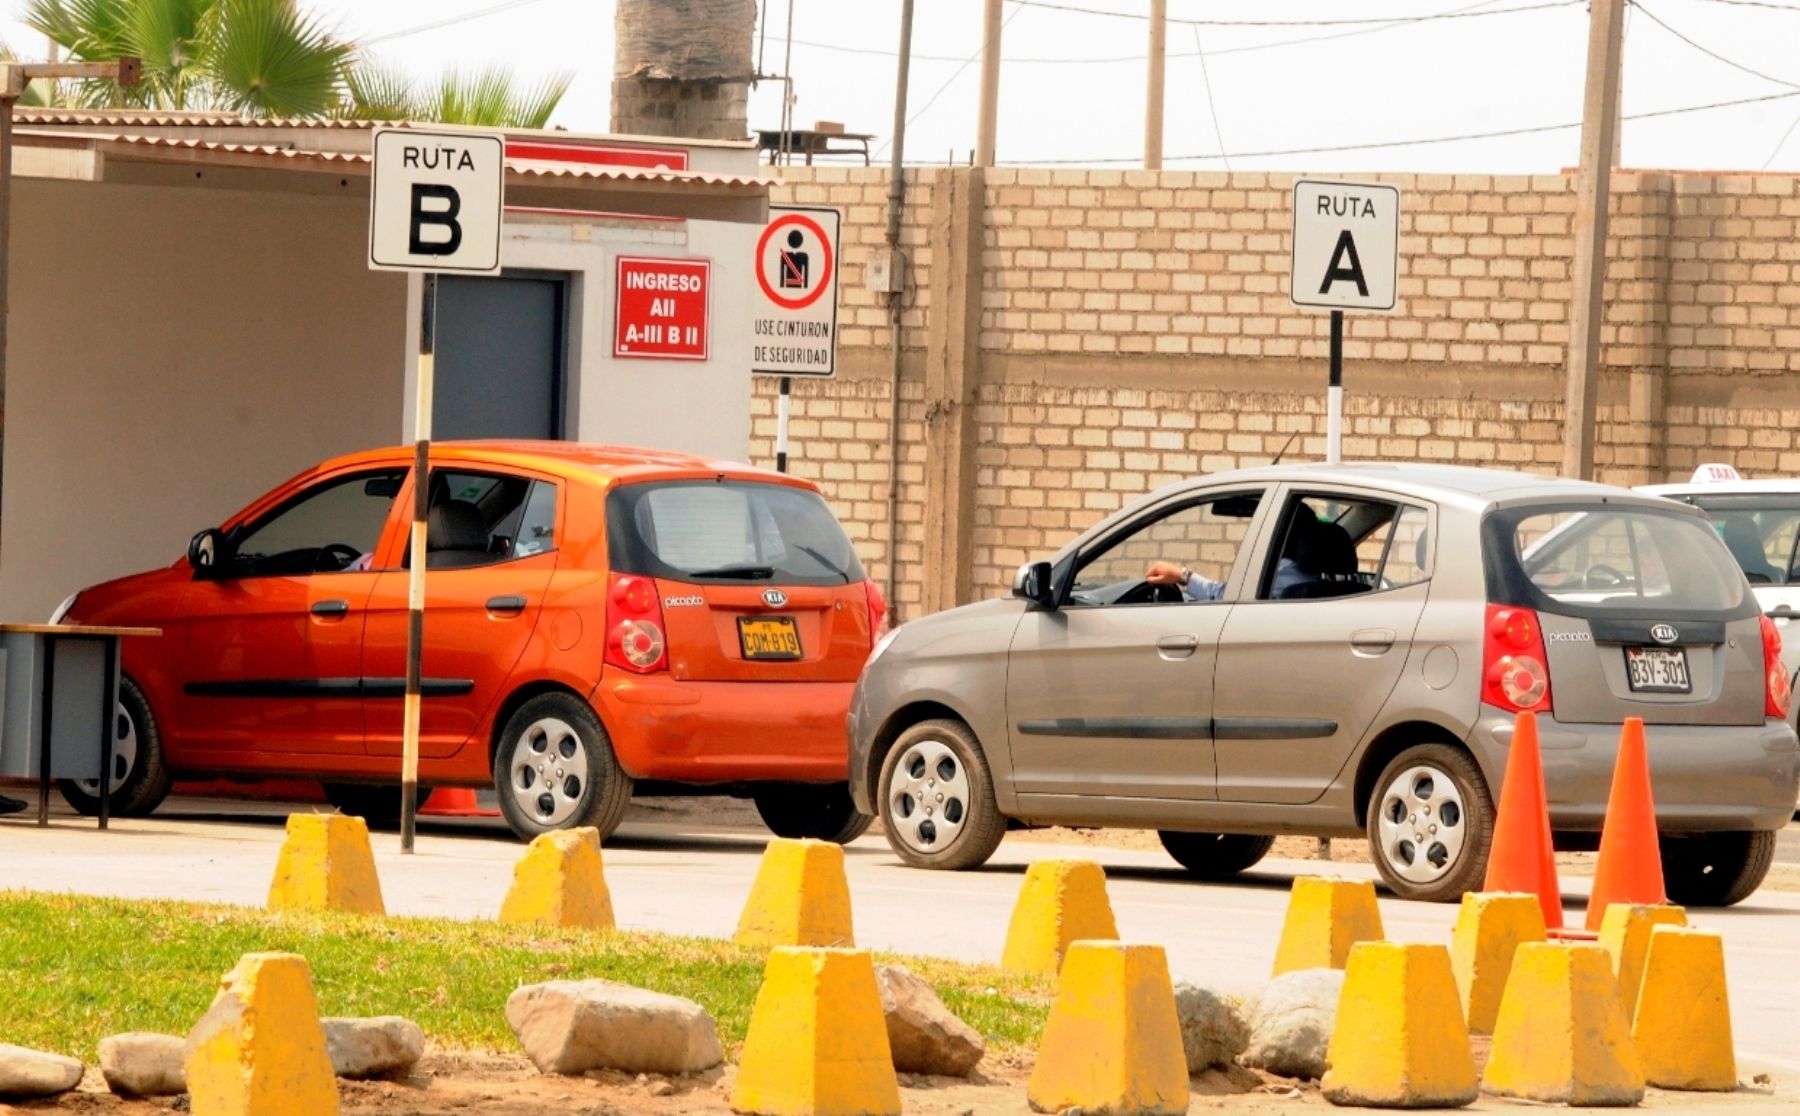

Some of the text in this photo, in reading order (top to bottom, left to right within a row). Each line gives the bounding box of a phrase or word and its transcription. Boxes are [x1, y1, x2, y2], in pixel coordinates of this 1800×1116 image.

[404, 147, 474, 171] RUTA
[1318, 195, 1376, 218] RUTA
[409, 183, 462, 255] B
[1319, 229, 1369, 297] A
[627, 271, 701, 292] INGRESO
[625, 323, 698, 345] A-III B II
[755, 319, 829, 338] USE CINTURON
[755, 346, 828, 365] DE SEGURIDAD
[1708, 467, 1735, 480] TAXI
[765, 591, 785, 605] KIA
[1654, 626, 1677, 640] KIA
